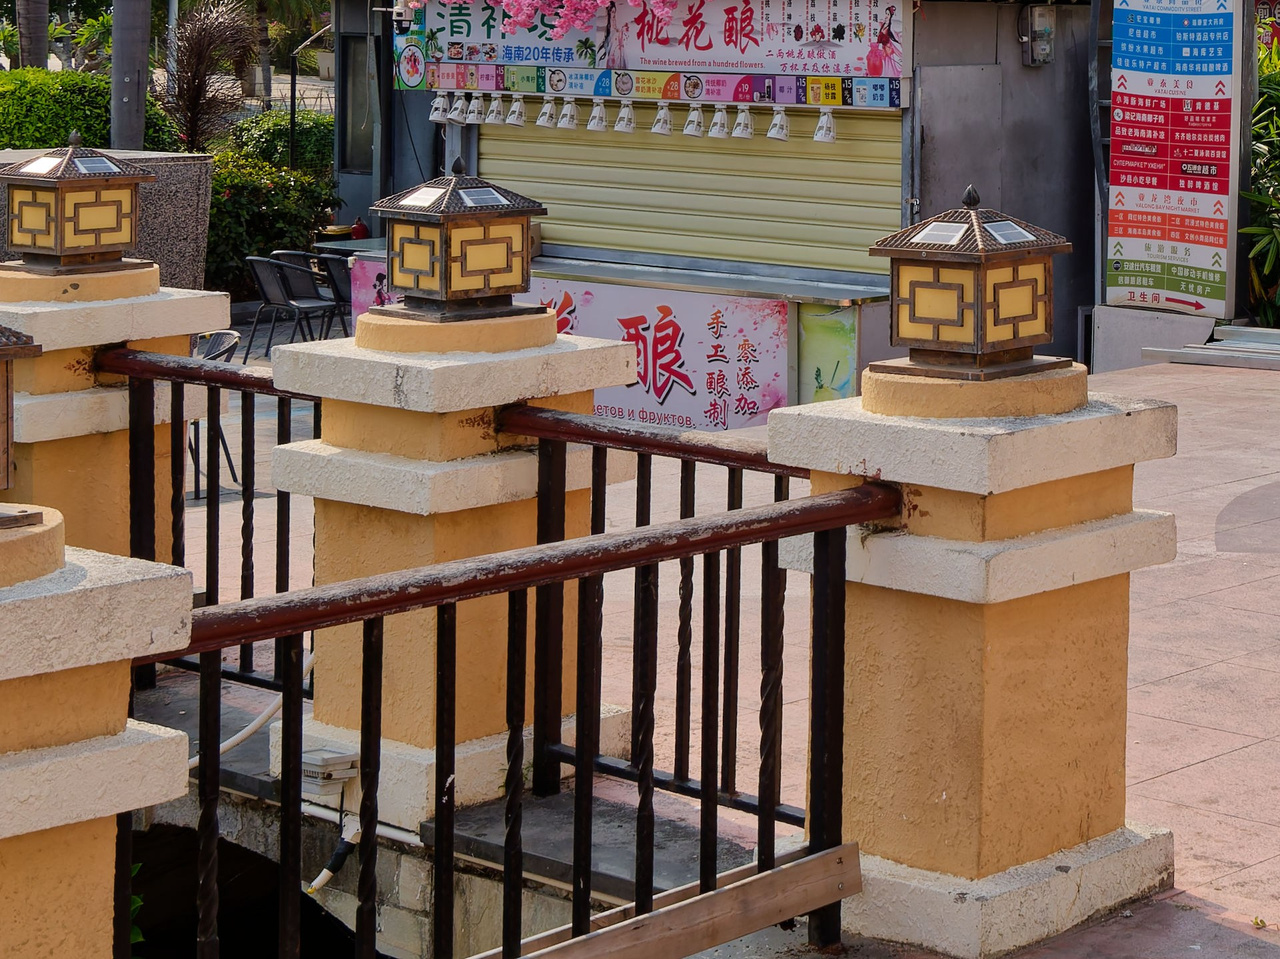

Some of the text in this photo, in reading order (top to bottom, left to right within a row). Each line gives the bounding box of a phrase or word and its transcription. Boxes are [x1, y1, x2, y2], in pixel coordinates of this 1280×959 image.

[502, 44, 574, 63] 海南20年传承
[640, 57, 651, 65] The
[652, 58, 668, 66] wine
[668, 58, 691, 66] brewed
[692, 59, 707, 67] from
[712, 60, 738, 68] hundred
[740, 60, 765, 68] flowers.
[1196, 102, 1220, 110] 肯德基
[1167, 255, 1188, 263] SERVICES
[1128, 291, 1160, 303] 卫生间
[704, 310, 730, 429] 手工酿制
[735, 339, 758, 415] 零添加
[628, 410, 634, 418] и
[638, 407, 696, 428] фруктов.
